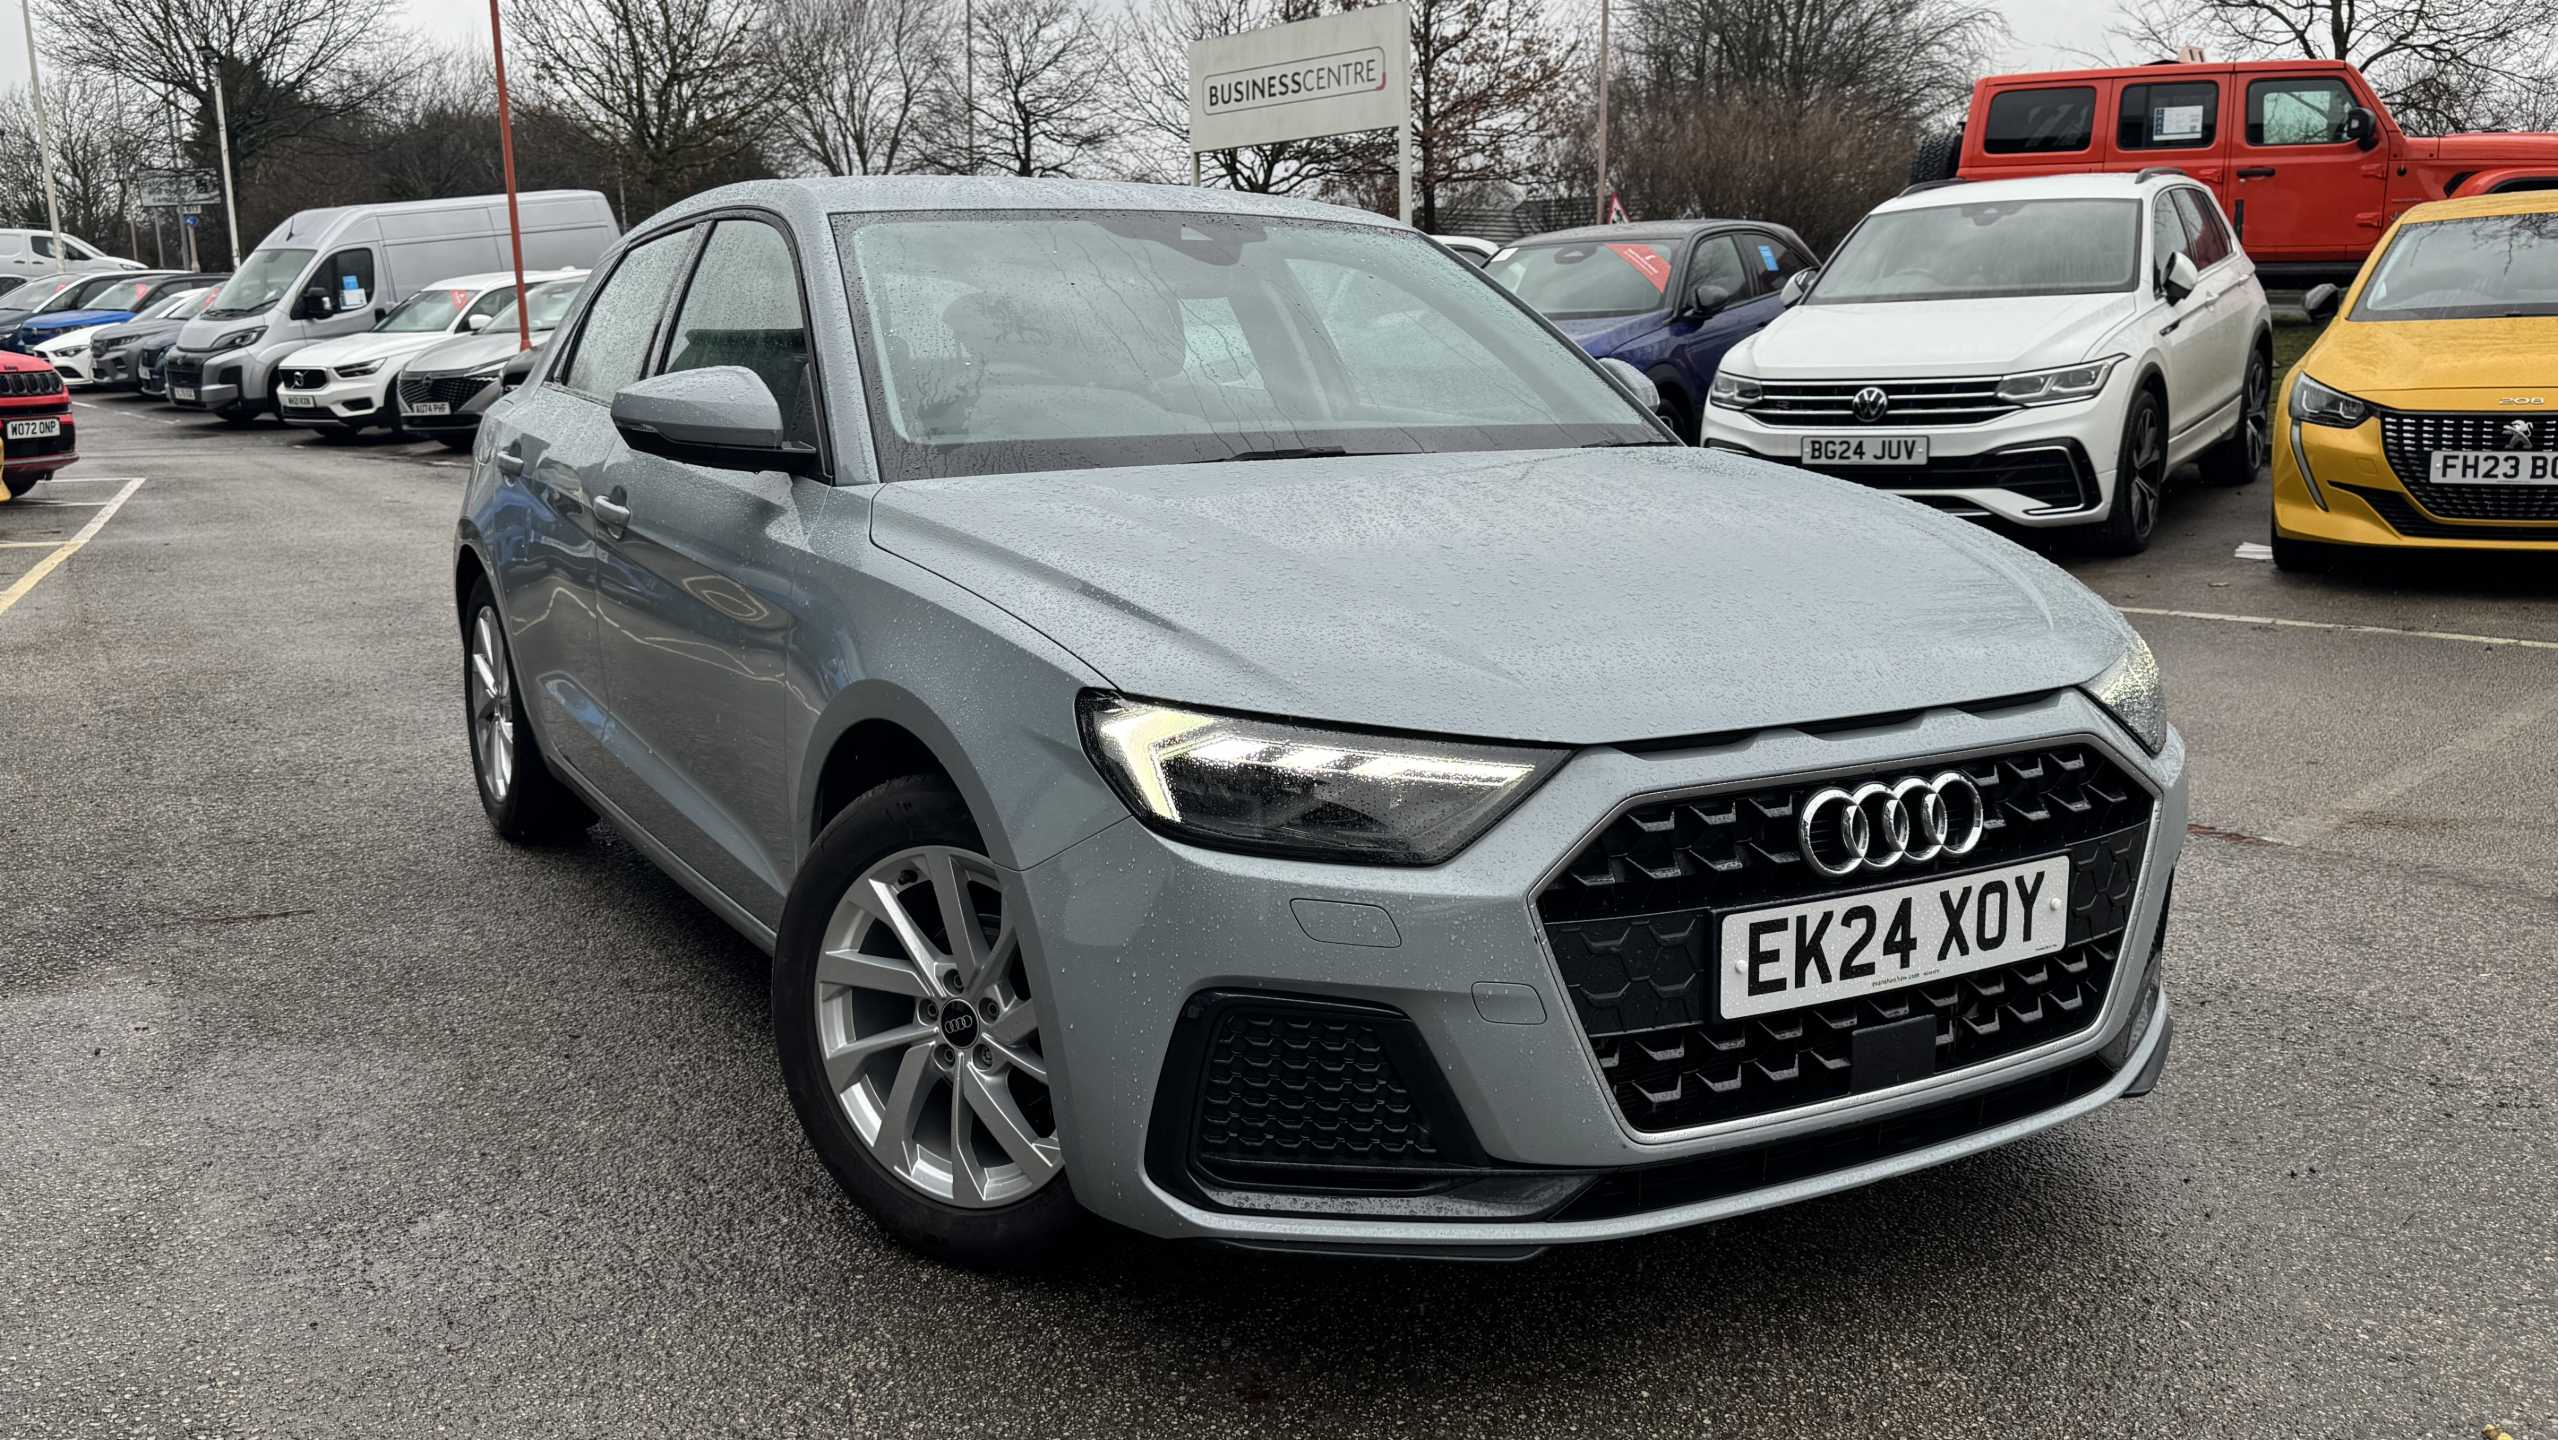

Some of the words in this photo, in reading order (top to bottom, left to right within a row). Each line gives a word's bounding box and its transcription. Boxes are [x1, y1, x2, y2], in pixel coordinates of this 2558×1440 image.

[1209, 58, 1377, 107] BUSINESSCENTRE
[1810, 440, 1866, 460] BG24
[1873, 440, 1916, 460] JUV
[2441, 455, 2520, 479] FH23
[1747, 896, 1918, 997] EK24
[1936, 870, 2046, 962] XOY
